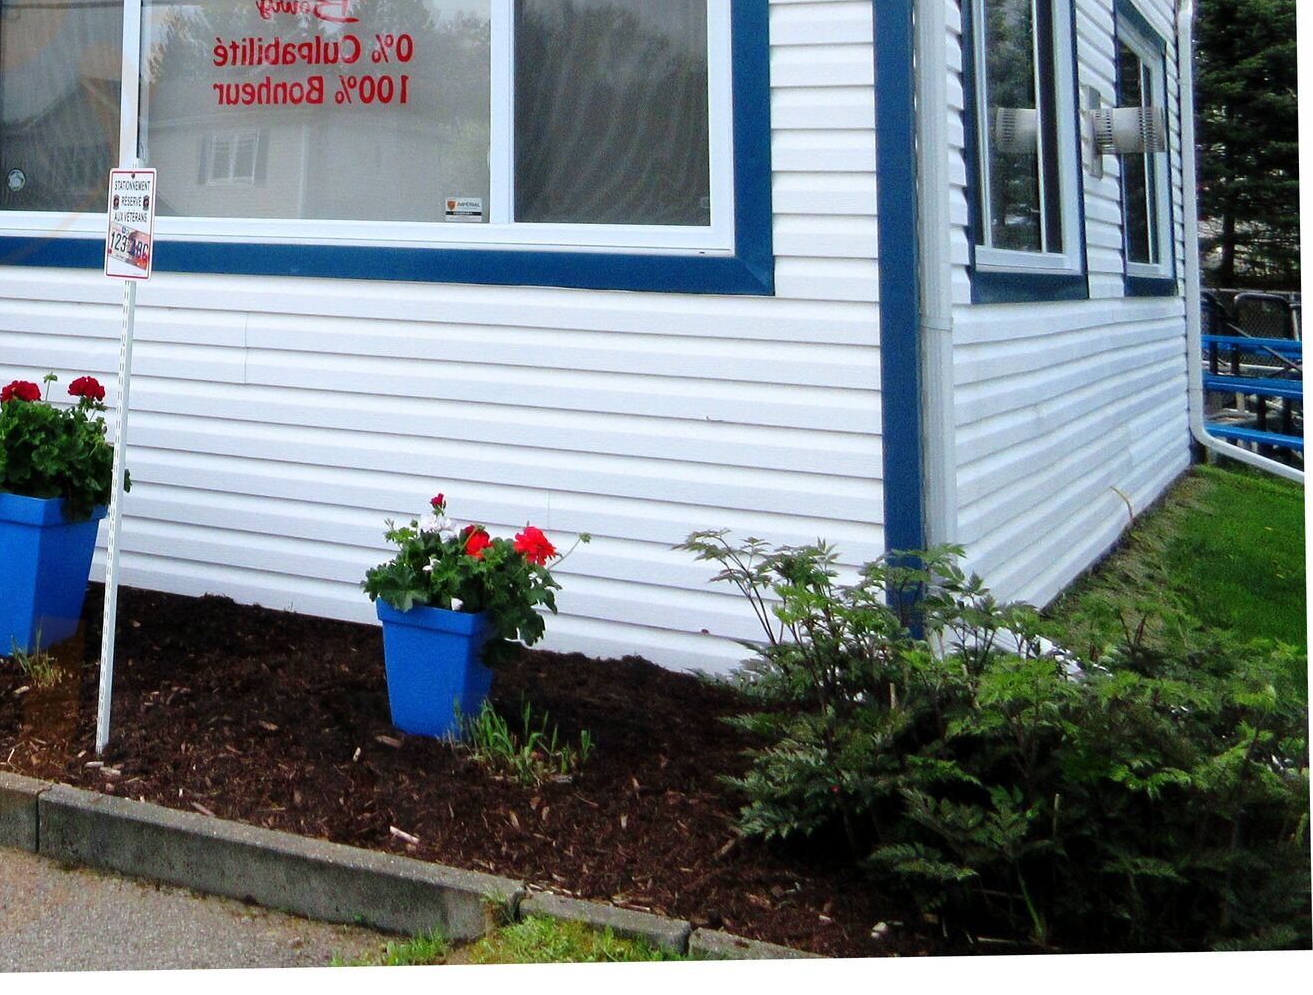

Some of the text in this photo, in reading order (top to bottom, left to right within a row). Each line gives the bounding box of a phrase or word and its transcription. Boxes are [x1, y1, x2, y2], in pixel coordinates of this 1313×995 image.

[114, 180, 151, 191] STATIONNEMENT
[114, 211, 124, 222] AUX
[111, 231, 128, 253] 123
